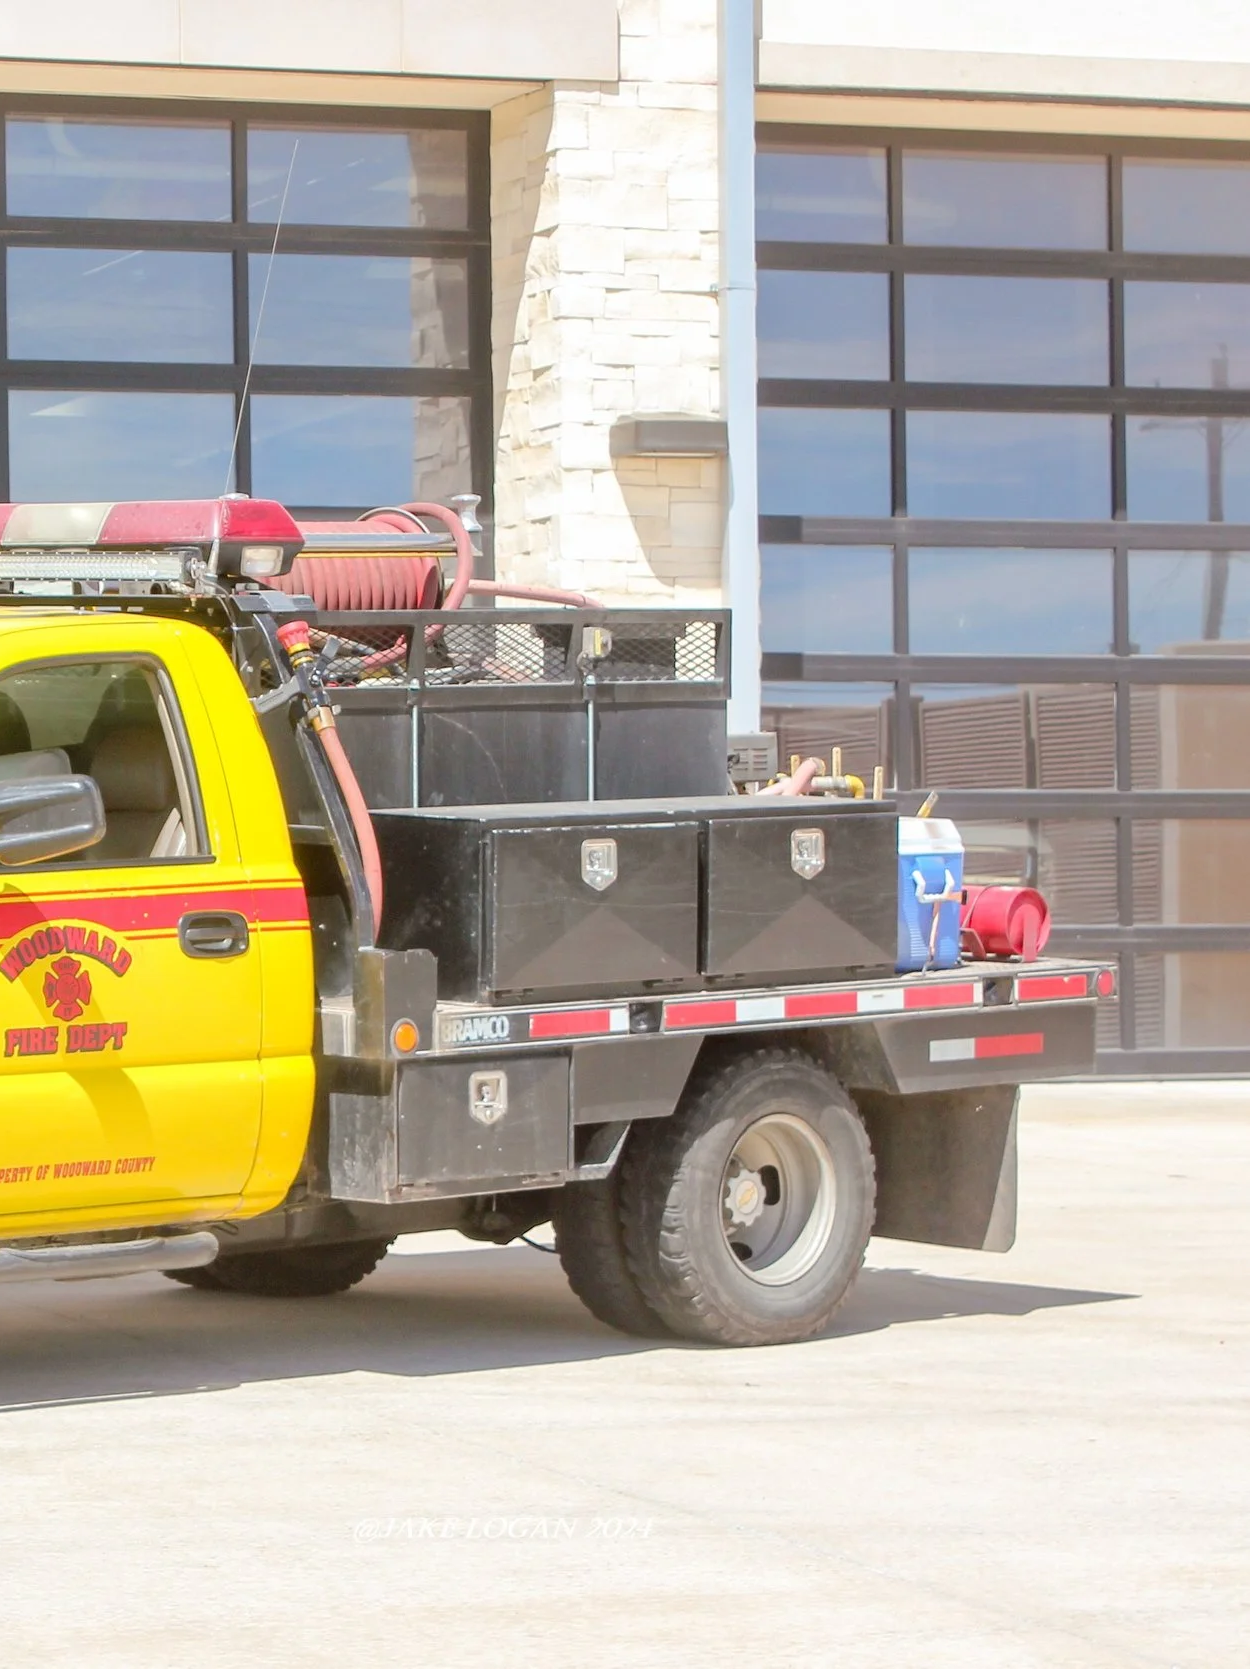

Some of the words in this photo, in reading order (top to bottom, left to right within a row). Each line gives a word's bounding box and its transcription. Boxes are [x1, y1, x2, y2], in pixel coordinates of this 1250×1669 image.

[4, 1026, 59, 1058] FIRE
[65, 1022, 128, 1053] DEPT
[440, 1015, 510, 1041] BRAMCO
[35, 1164, 50, 1180] OF
[53, 1160, 112, 1179] WOODWARD
[114, 1156, 156, 1174] COUNTY
